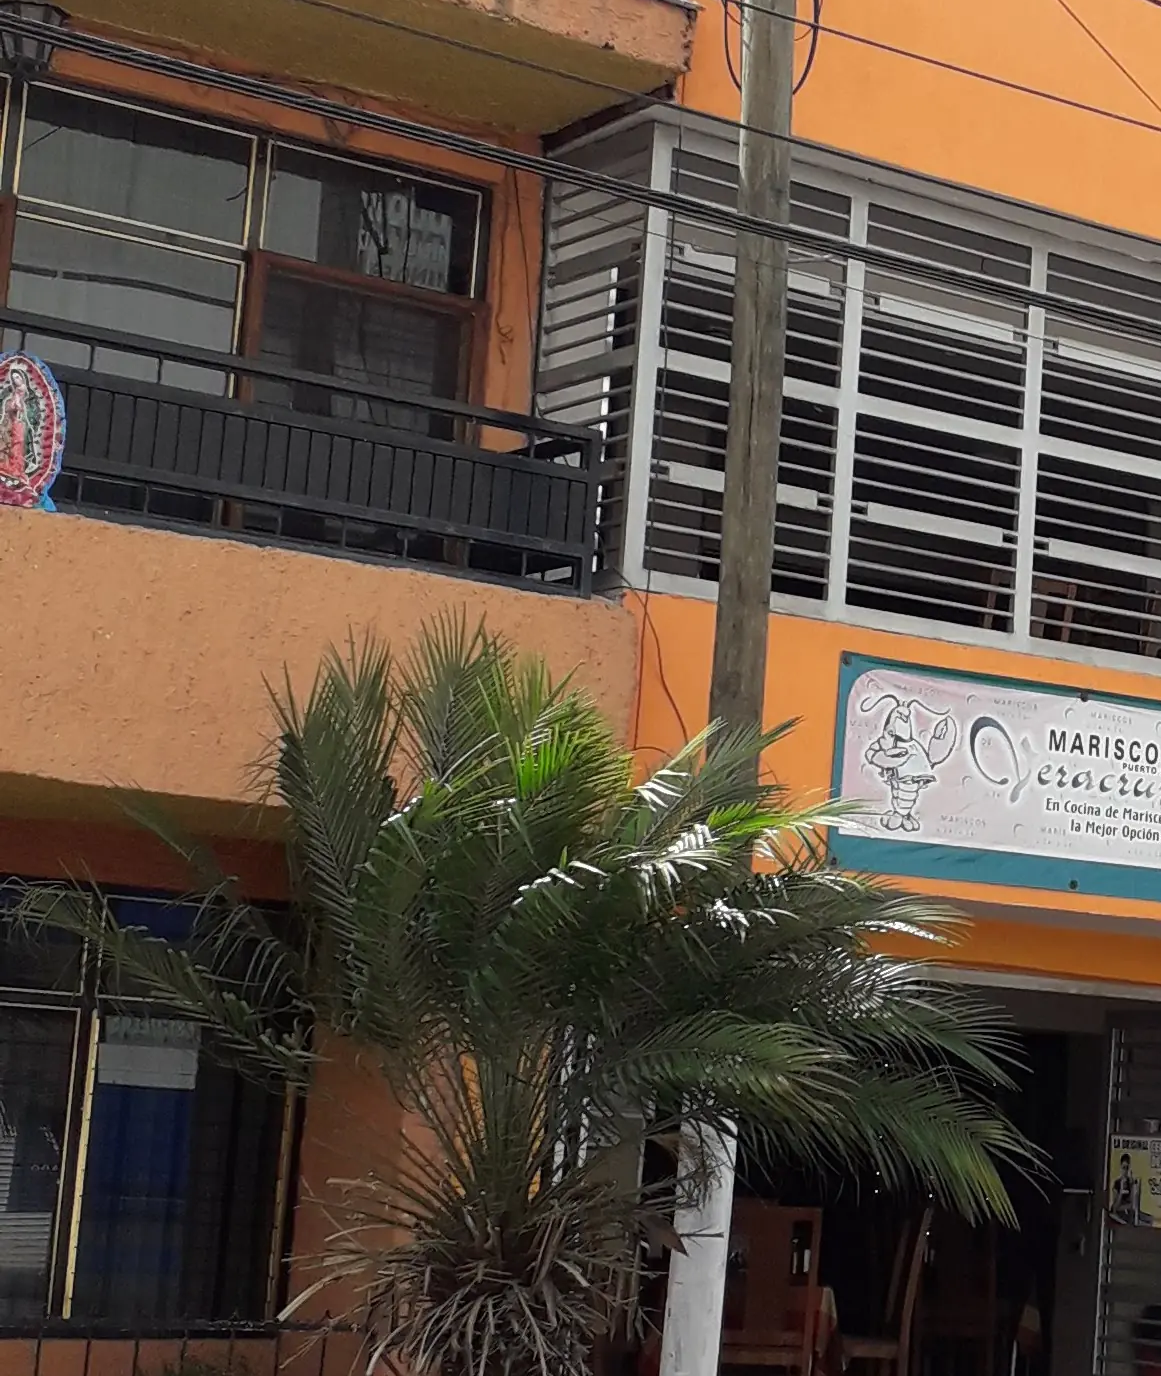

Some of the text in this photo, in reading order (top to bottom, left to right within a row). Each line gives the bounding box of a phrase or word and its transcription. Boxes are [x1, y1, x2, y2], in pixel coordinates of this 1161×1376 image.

[1122, 762, 1157, 775] PUERTO
[1045, 796, 1061, 813] En
[1063, 799, 1102, 818] Cocina
[1105, 803, 1120, 820] de
[1070, 818, 1161, 842] la Mejor Opción
